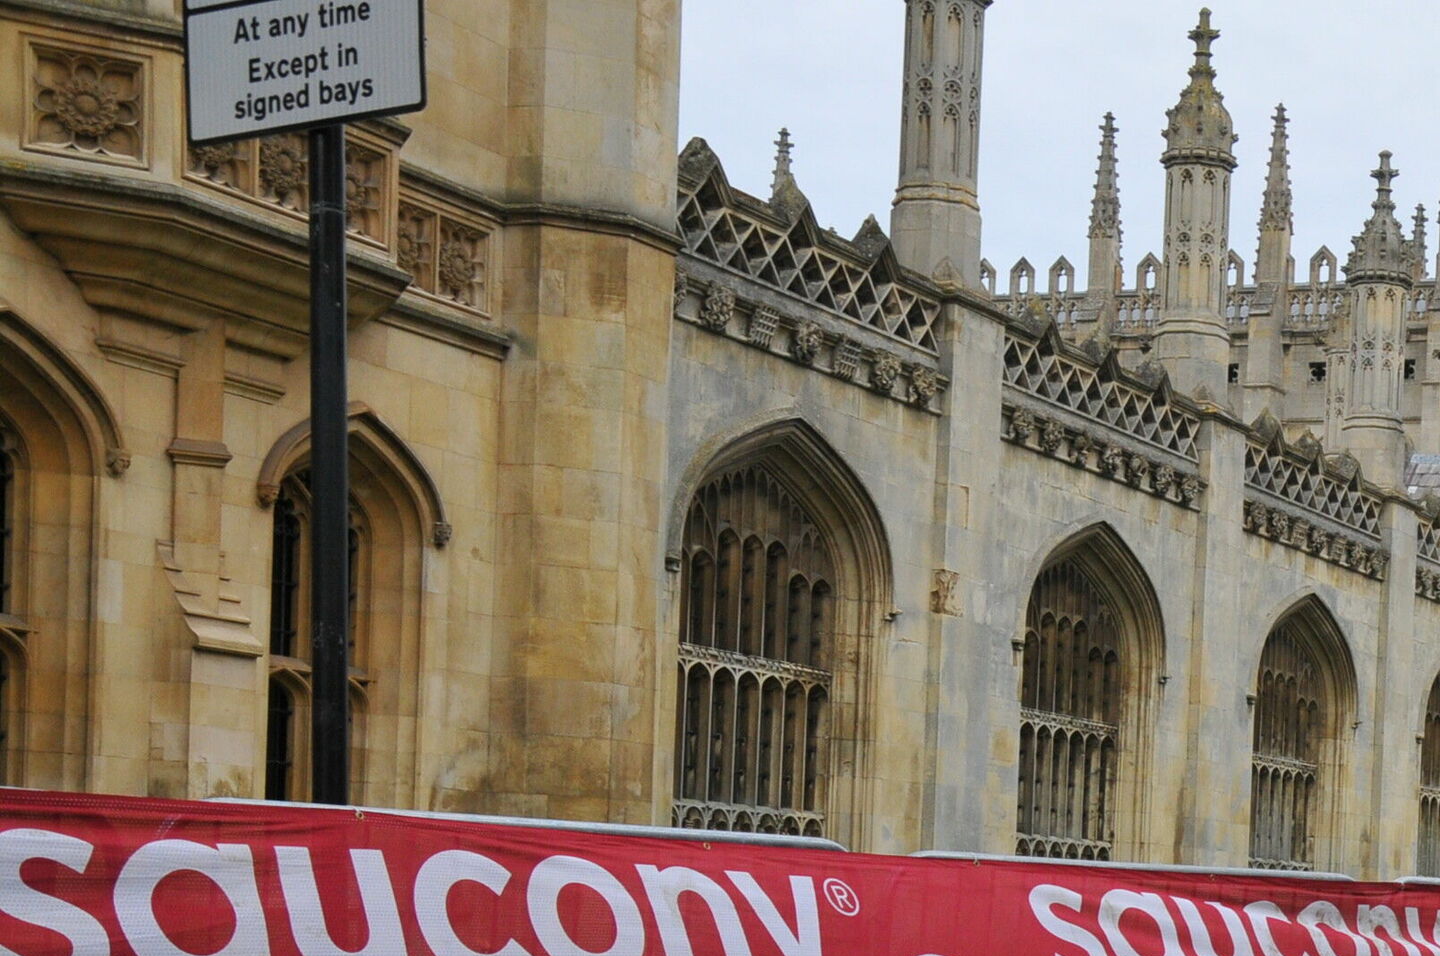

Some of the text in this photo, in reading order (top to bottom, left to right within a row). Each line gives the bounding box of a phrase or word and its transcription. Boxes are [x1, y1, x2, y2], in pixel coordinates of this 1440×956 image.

[234, 1, 371, 44] At any time
[248, 43, 358, 83] Except in
[234, 77, 373, 121] signed bays
